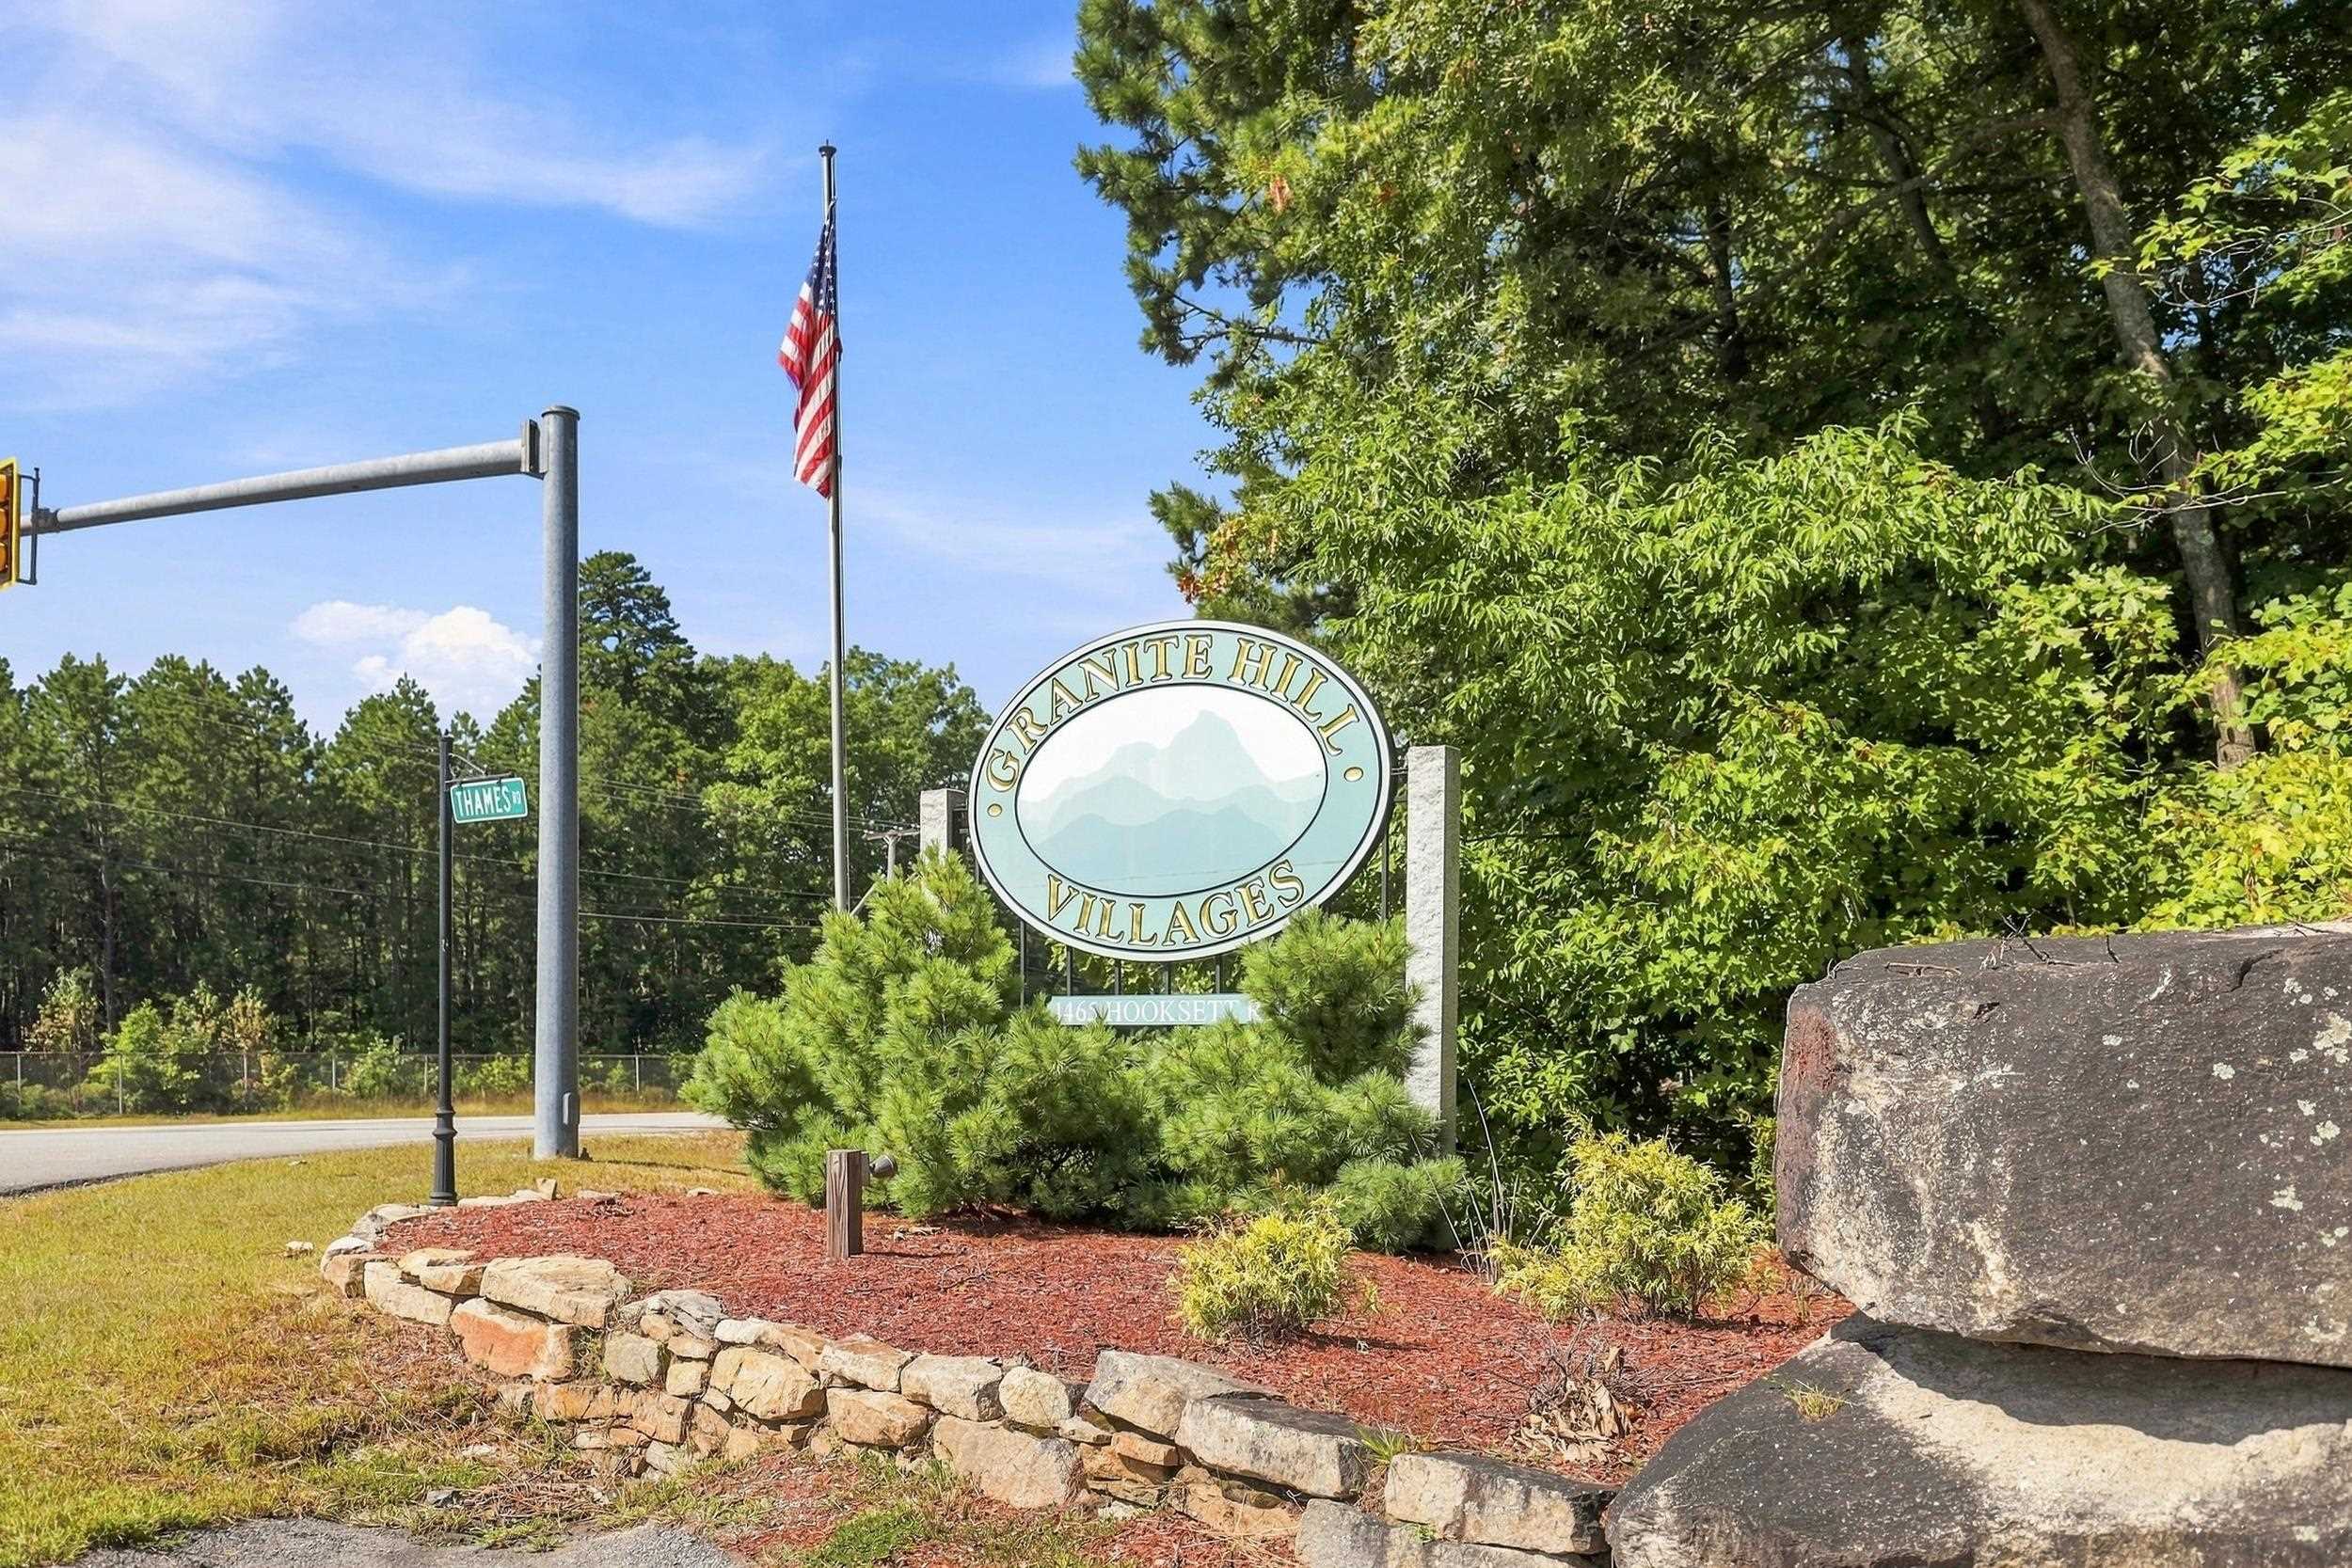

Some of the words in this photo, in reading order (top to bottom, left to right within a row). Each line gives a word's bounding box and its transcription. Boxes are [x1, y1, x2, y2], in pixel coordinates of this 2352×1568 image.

[986, 634, 1214, 792] GRANITE
[1227, 637, 1360, 756] HILL
[454, 785, 512, 816] THAMES
[1046, 859, 1305, 947] VILLAGES
